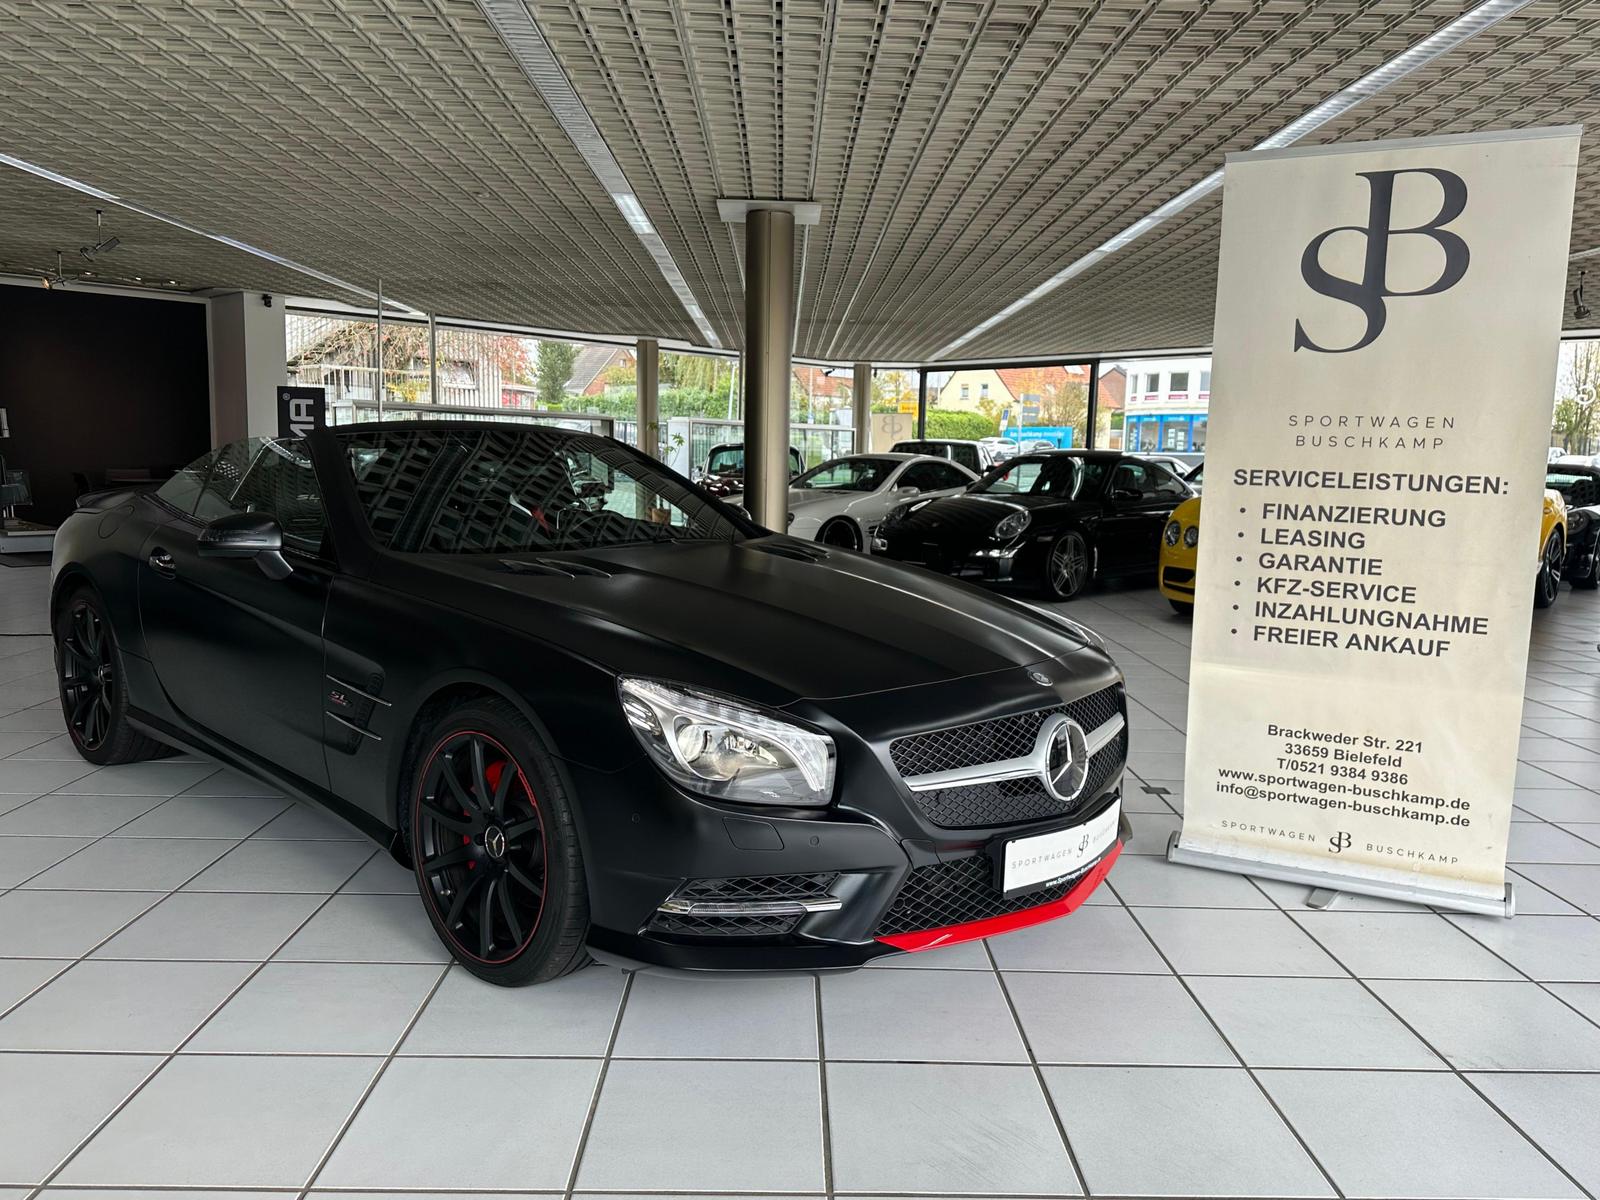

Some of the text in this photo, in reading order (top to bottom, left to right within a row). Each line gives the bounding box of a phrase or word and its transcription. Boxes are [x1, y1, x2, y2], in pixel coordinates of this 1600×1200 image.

[1288, 414, 1456, 429] SPORTWAGEN
[1295, 435, 1445, 449] BUSCHKAMP
[1233, 468, 1510, 495] SERVICELEISTUNGEN:
[1262, 502, 1447, 527] FINANZIERUNG
[1260, 527, 1366, 549] LEASING
[1258, 552, 1383, 576] GARANTIE
[1257, 576, 1417, 604] KFZ-SERVICE
[1254, 600, 1489, 635] INZAHLUNGNAHME
[1253, 625, 1451, 658] FREIER ANKAUF
[1267, 723, 1423, 753] Brackweder Str. 221
[1284, 742, 1403, 768] 33659 Bielefeld
[1276, 757, 1409, 785] T/0521 9384 9386
[1218, 768, 1471, 811] www.sportwagen-buschkamp.de
[1215, 781, 1471, 827] info@sportwagen-buschkamp.de
[1221, 819, 1317, 842] SPORTWAGEN
[1366, 843, 1459, 864] BUSCHKAMP
[1011, 848, 1073, 869] SPORTWAGEN
